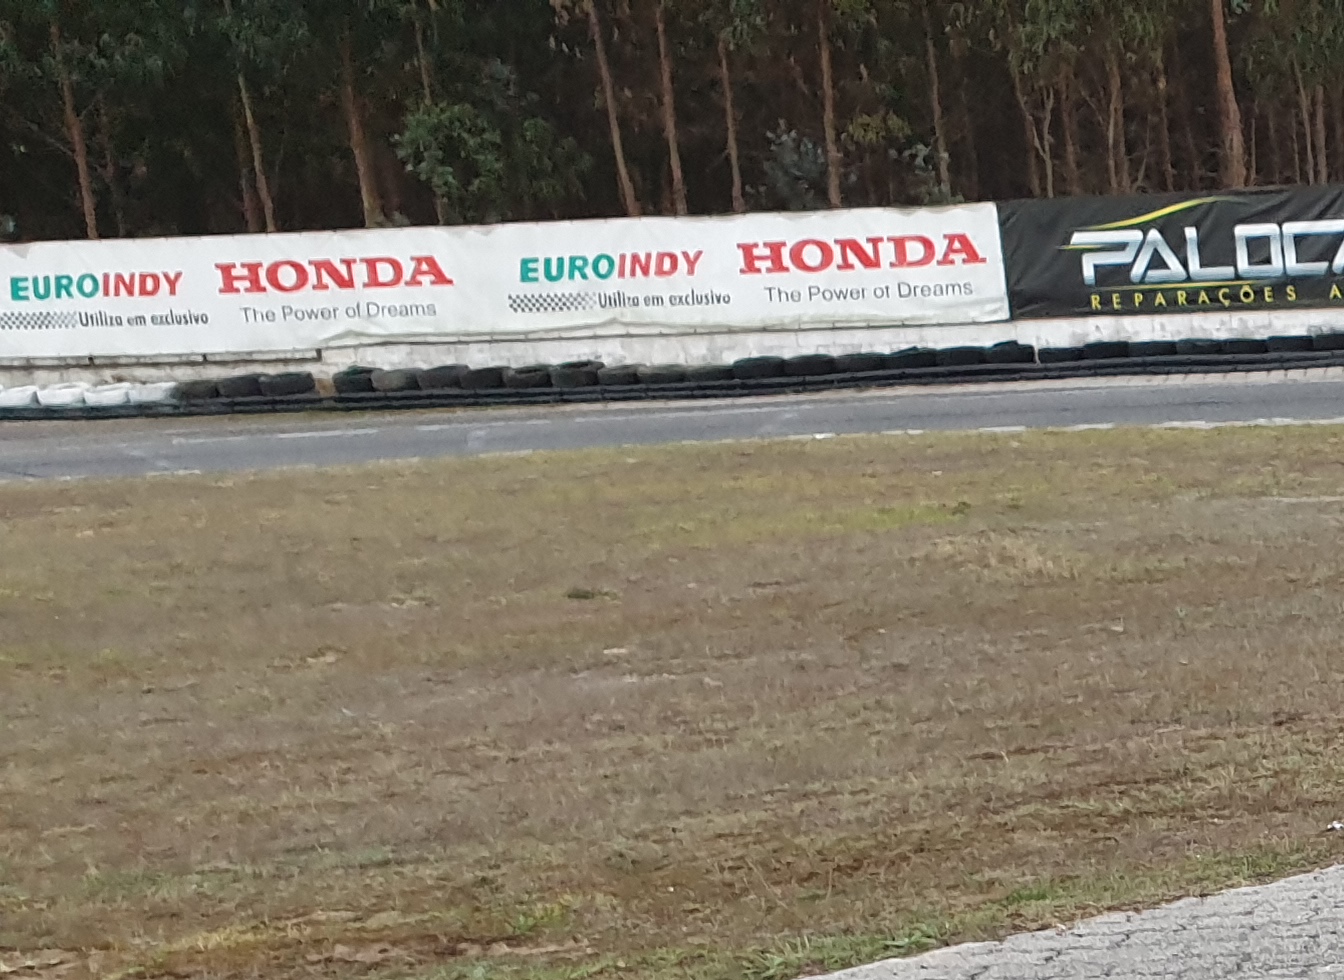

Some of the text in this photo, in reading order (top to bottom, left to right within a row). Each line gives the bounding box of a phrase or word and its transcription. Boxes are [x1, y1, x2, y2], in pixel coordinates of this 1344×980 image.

[519, 250, 703, 283] EUROINDY
[736, 232, 987, 275] HONDA
[9, 270, 183, 302] EUROINDY
[213, 254, 454, 295] HONDA
[643, 294, 666, 308] em
[764, 280, 974, 304] The Power of Dreams
[1090, 283, 1298, 311] REPARAÇÕES
[78, 308, 209, 329] Utiliza em exclusivo
[240, 301, 437, 324] The Power of Dreams
